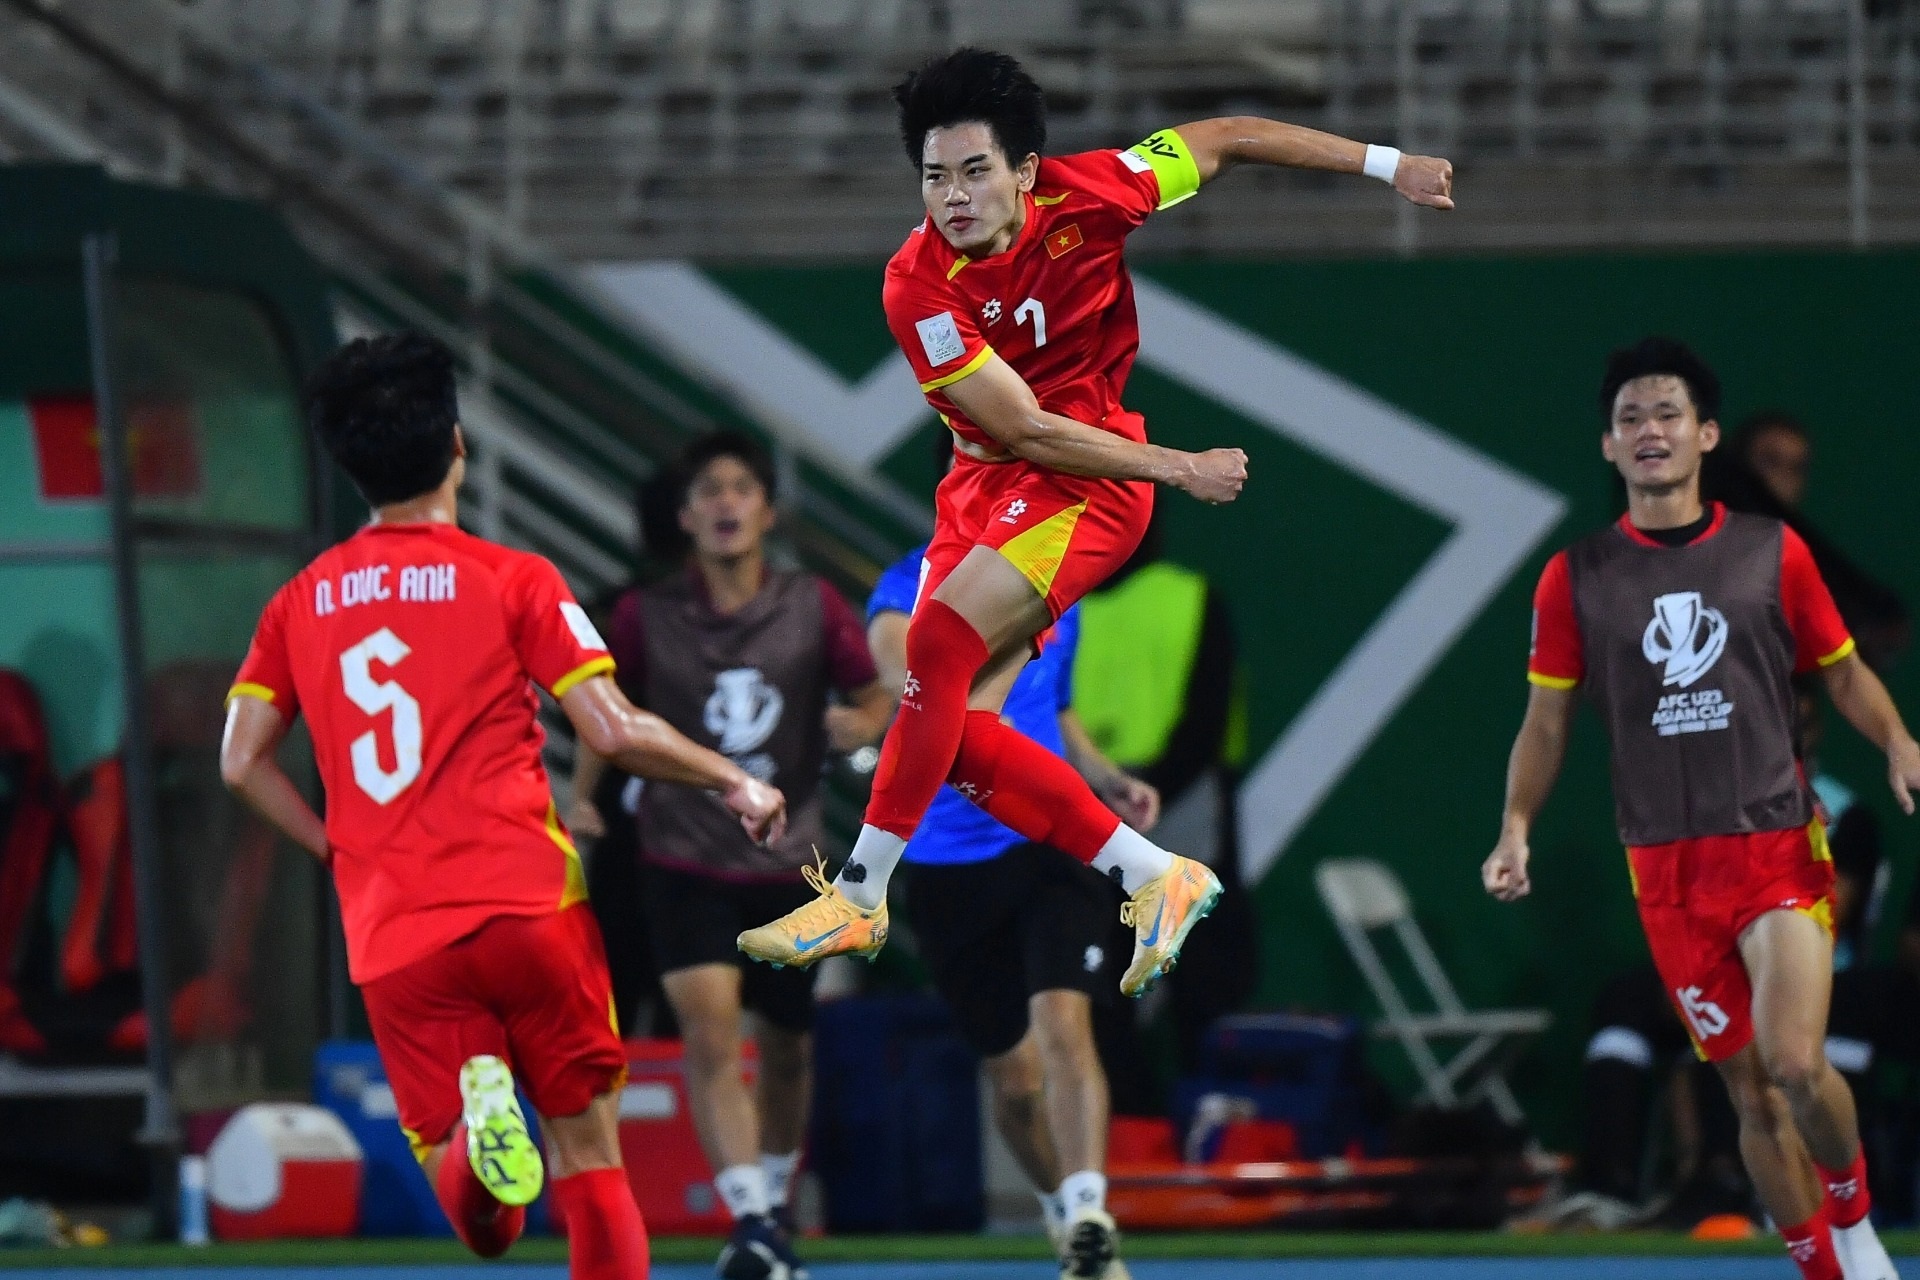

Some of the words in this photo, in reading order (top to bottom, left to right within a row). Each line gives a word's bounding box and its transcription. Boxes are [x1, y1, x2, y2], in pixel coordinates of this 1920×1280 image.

[1140, 136, 1180, 159] AF
[1013, 297, 1047, 349] 7
[399, 563, 456, 602] ANH
[339, 626, 422, 806] 5
[1658, 693, 1690, 710] AFC
[1699, 702, 1734, 720] CUP
[1676, 985, 1730, 1041] 15
